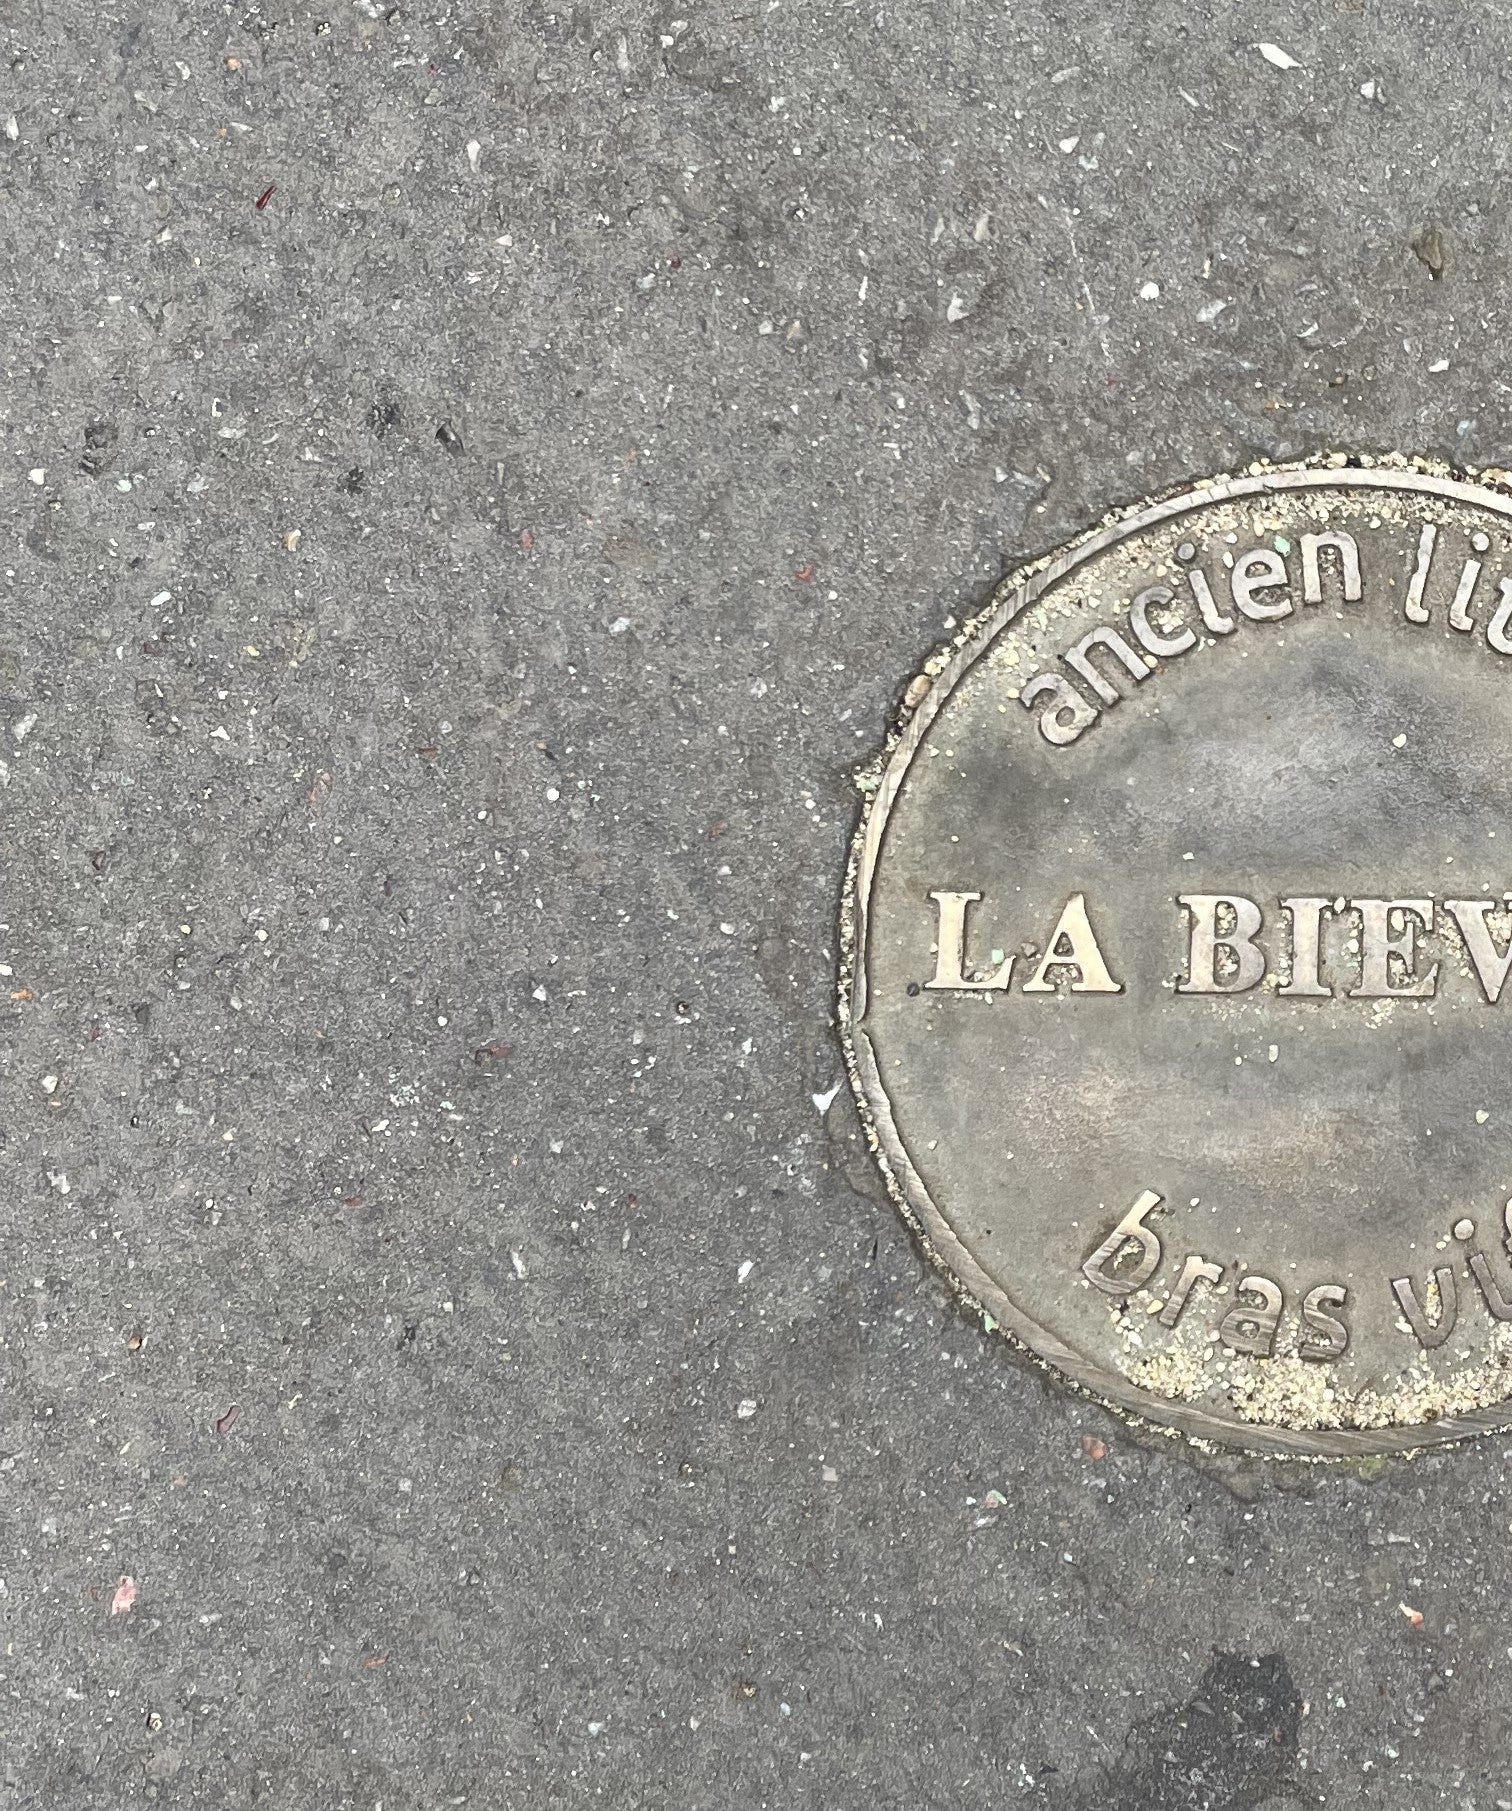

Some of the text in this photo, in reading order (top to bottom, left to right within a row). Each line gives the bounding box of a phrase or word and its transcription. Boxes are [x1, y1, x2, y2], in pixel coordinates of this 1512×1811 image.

[1020, 529, 1363, 746] ancien
[924, 890, 1123, 993] LA
[1081, 1188, 1349, 1362] bras
